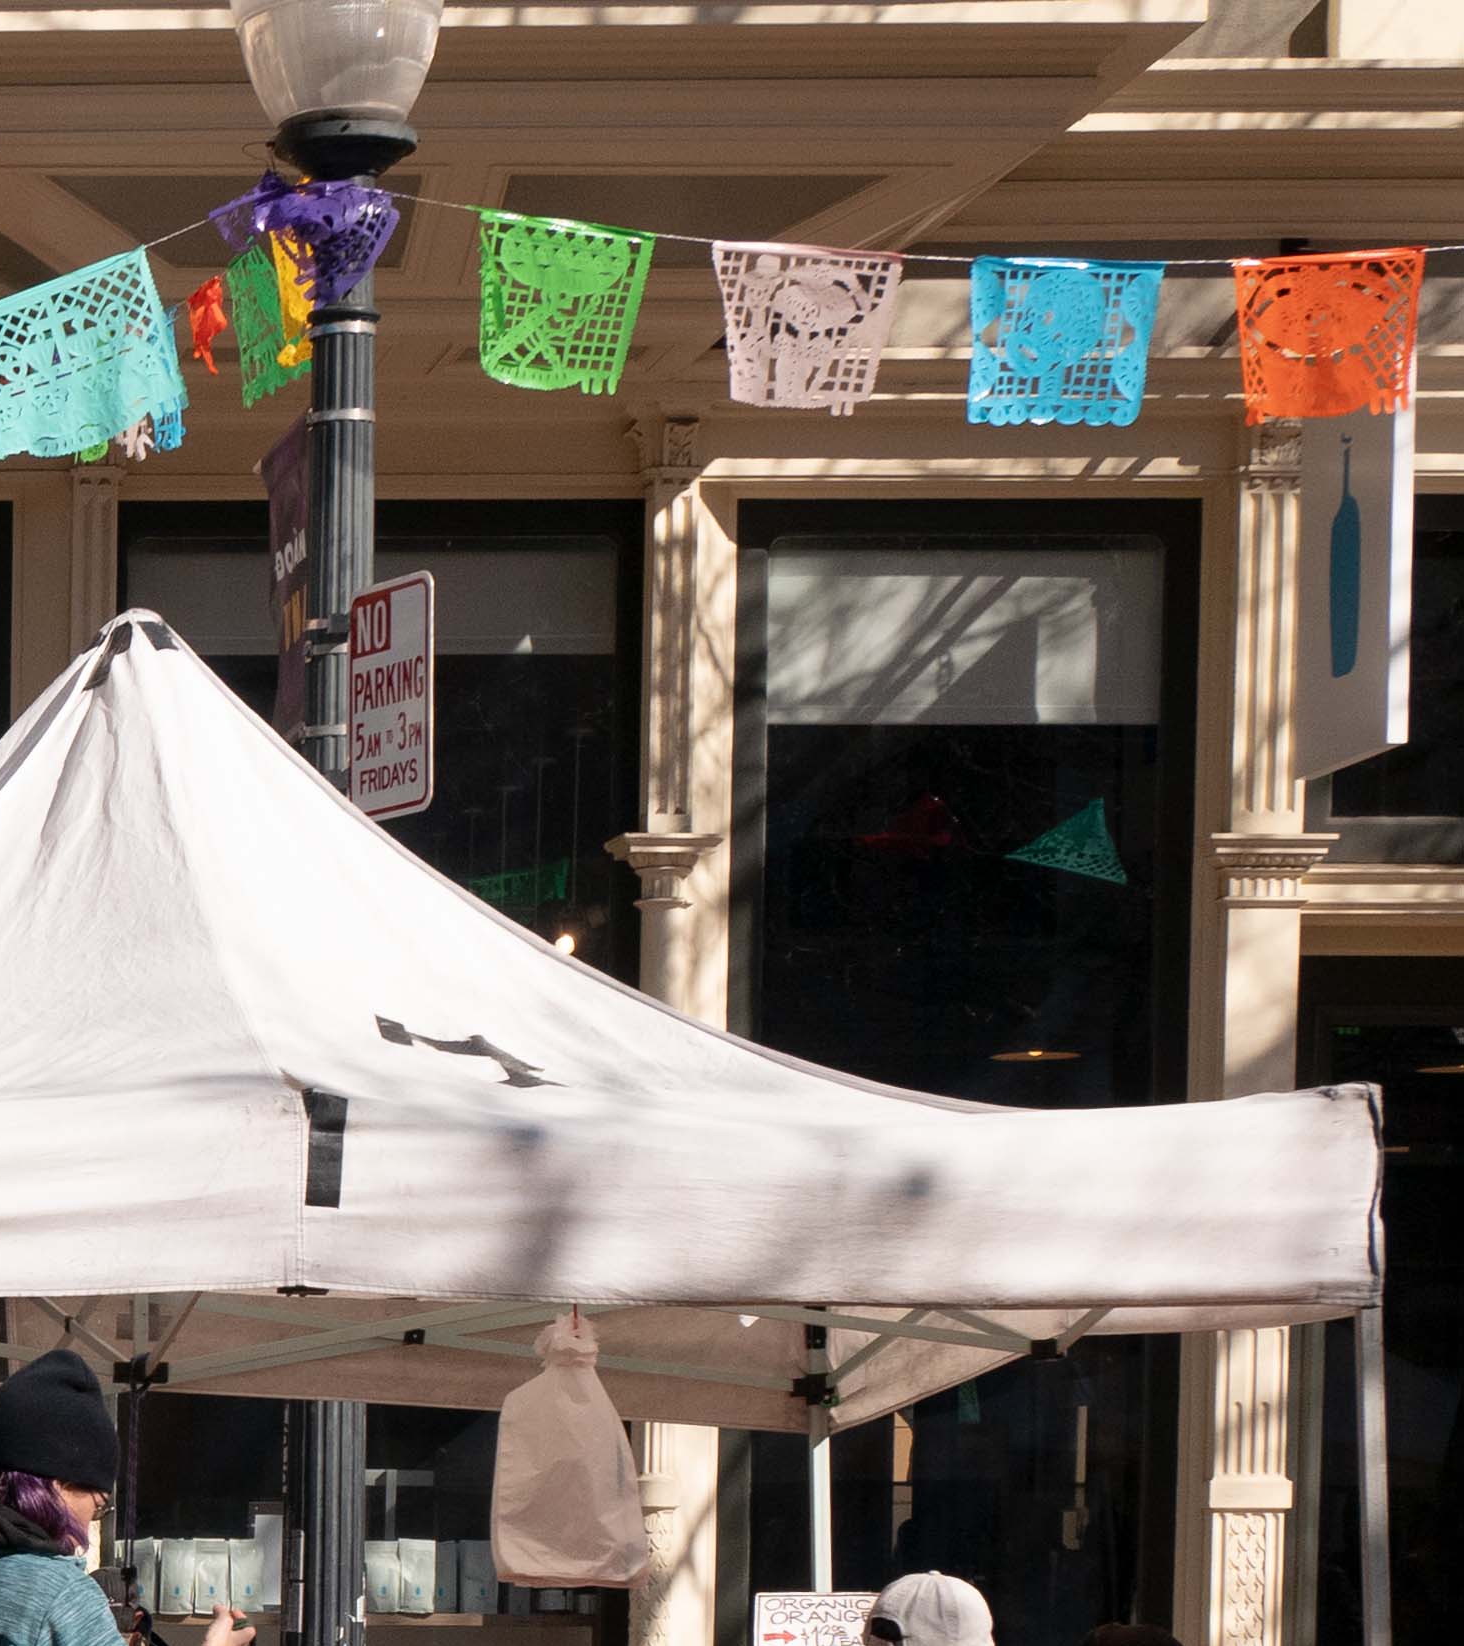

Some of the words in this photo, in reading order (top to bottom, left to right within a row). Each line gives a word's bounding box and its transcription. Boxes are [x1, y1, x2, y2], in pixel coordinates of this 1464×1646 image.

[356, 600, 388, 656] NO
[354, 655, 425, 716] PARKING
[359, 758, 419, 796] FRIDAYS
[764, 1598, 871, 1612] ORGANIC
[770, 1610, 869, 1625] ORANGE
